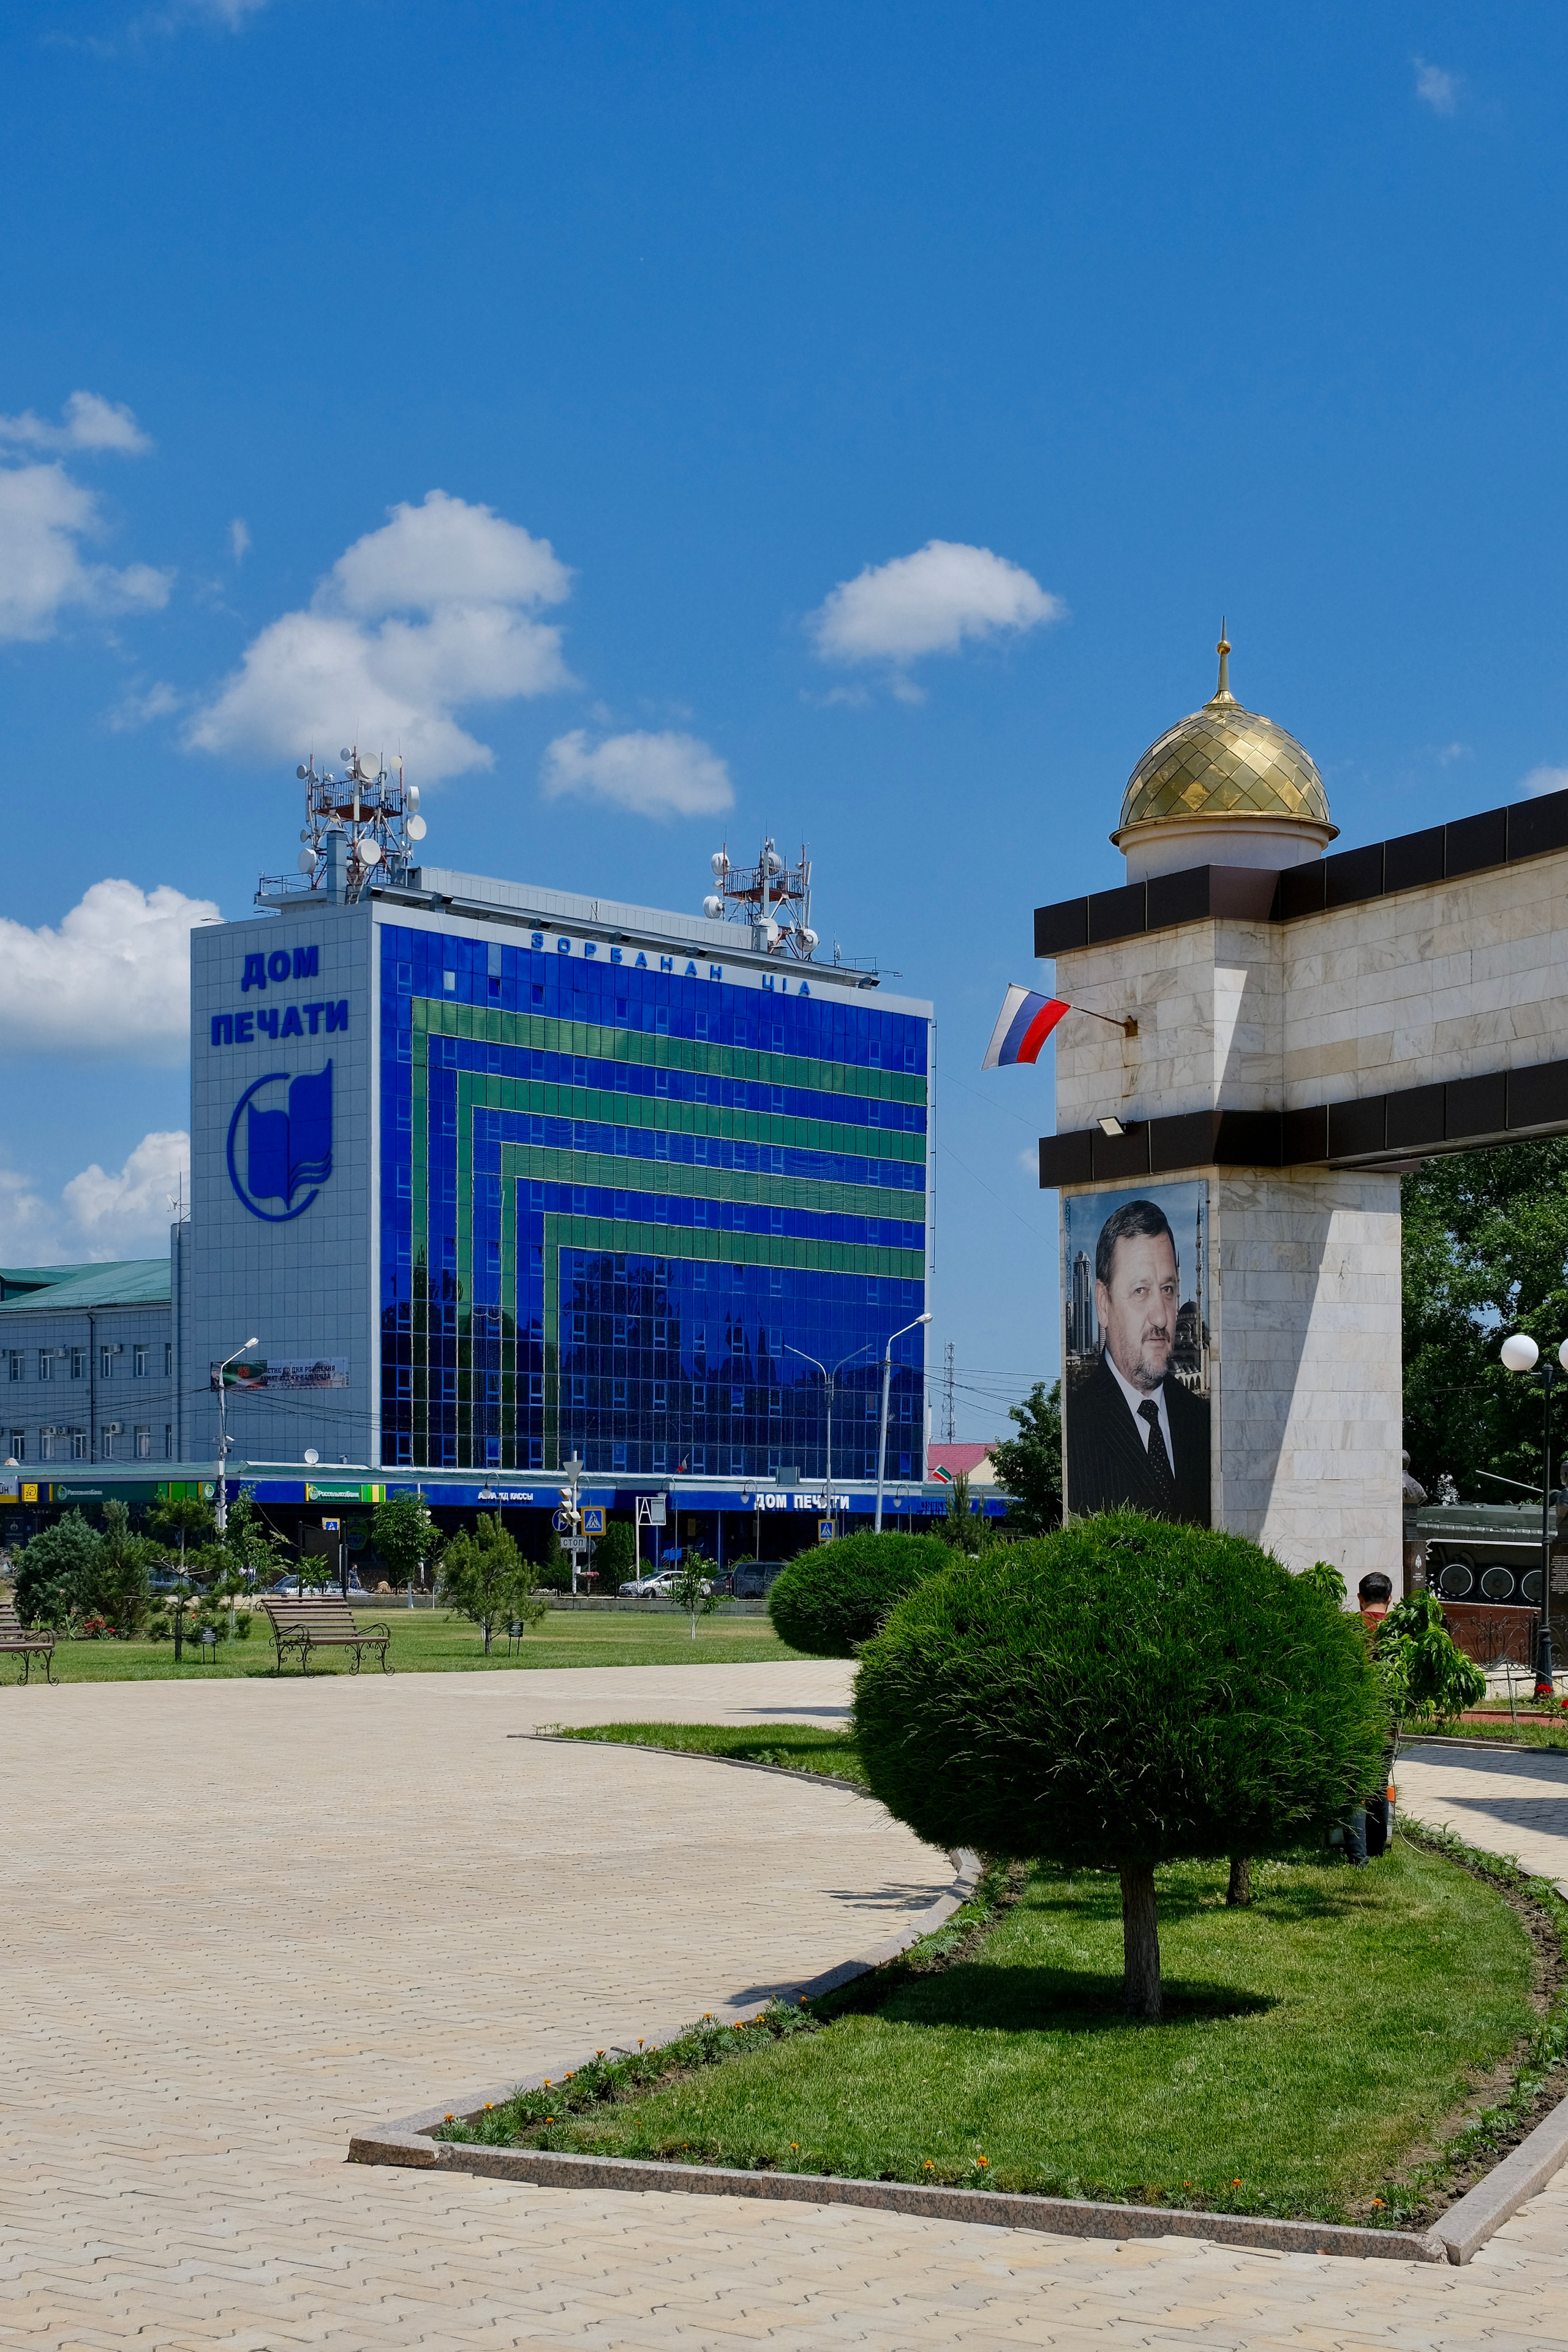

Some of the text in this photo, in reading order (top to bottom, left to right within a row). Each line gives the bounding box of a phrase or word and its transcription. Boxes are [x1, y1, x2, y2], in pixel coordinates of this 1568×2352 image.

[241, 945, 318, 992] ДОМ
[531, 932, 722, 980] ЗОРБАНАН
[211, 999, 349, 1046] ПЕЧАТИ
[238, 1366, 250, 1377] 23
[754, 1493, 787, 1510] ДОМ
